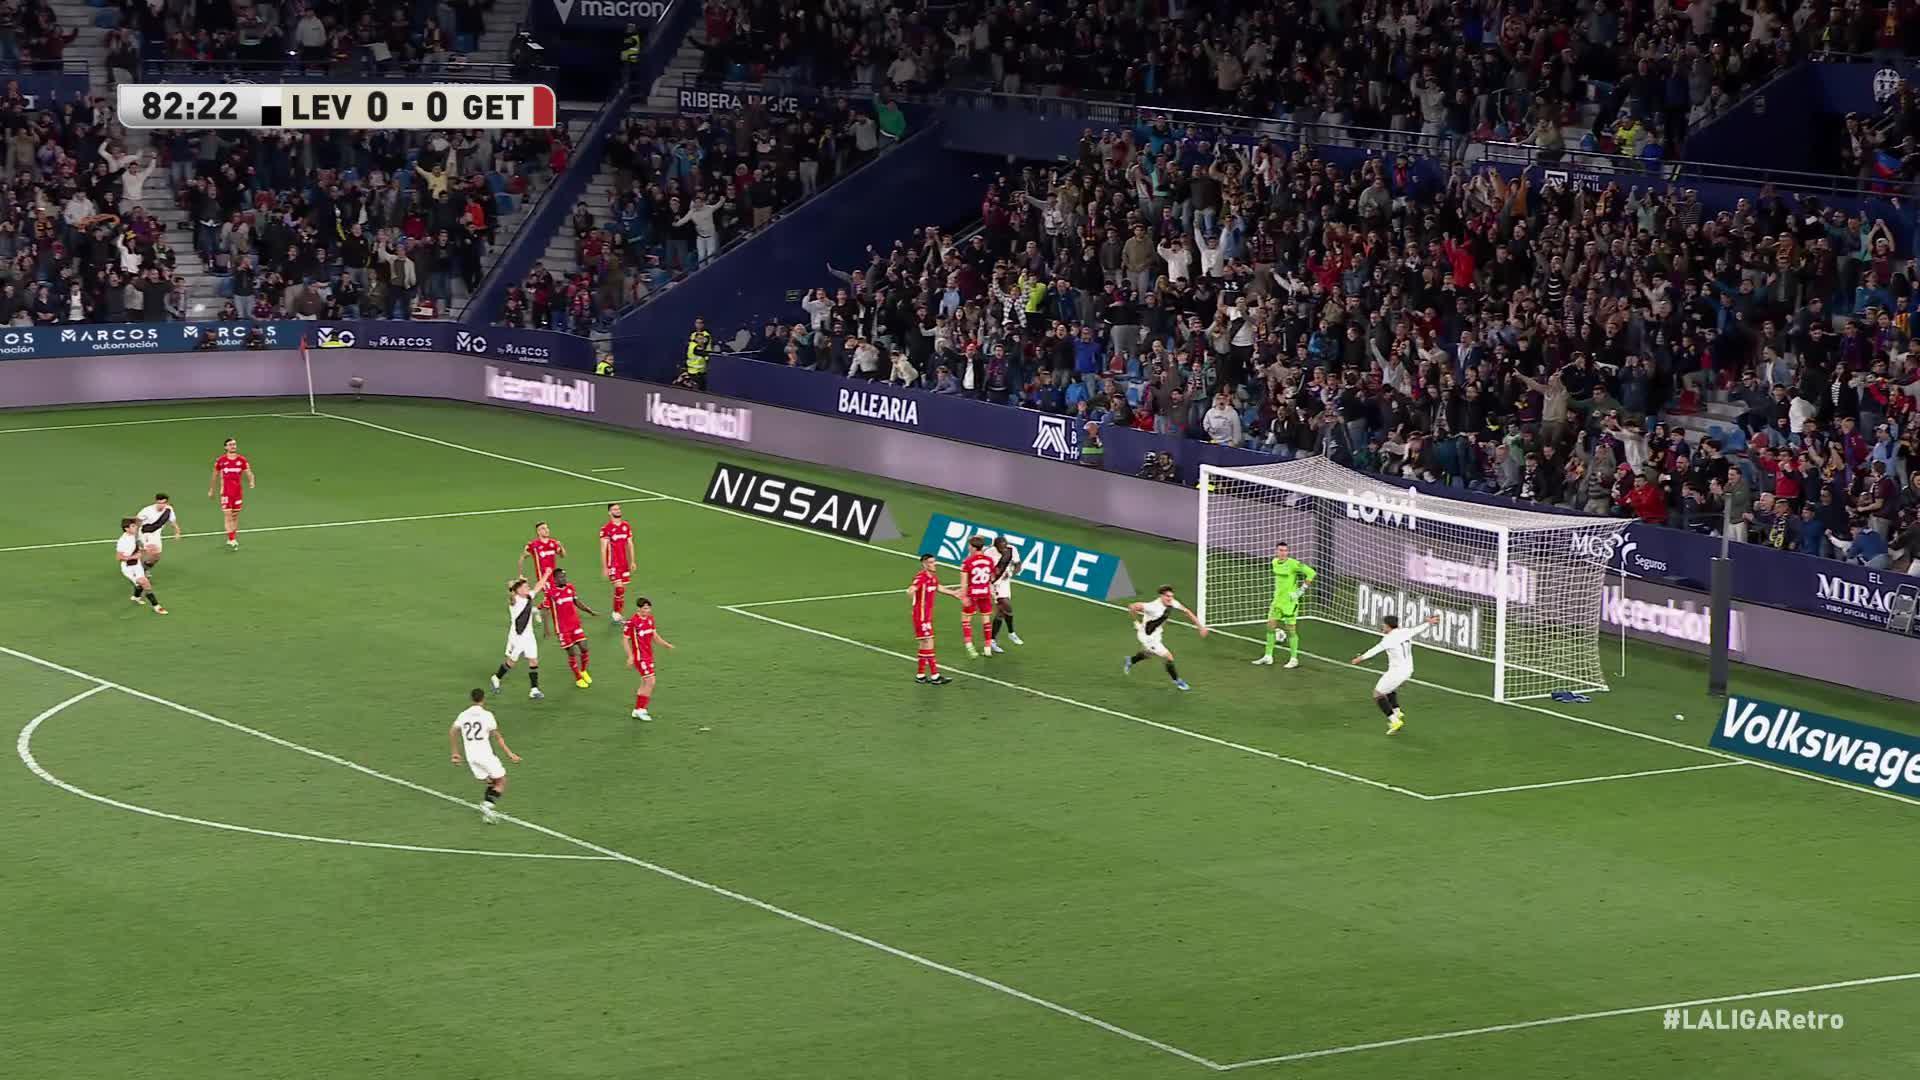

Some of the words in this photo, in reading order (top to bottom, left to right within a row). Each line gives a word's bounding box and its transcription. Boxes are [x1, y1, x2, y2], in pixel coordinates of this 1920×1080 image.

[581, 1, 664, 17] macron
[680, 91, 742, 109] RIBERA
[61, 329, 158, 342] MARCOS
[184, 326, 276, 338] MRCS
[92, 341, 158, 350] automoción
[379, 336, 432, 346] MARCOS
[505, 344, 549, 357] MARCOS
[710, 469, 878, 536] NISSAN
[1571, 533, 1614, 560] MGS
[1635, 554, 1667, 571] Seguros
[971, 567, 991, 584] 26
[1868, 572, 1883, 584] EL
[1816, 573, 1913, 615] MIRAC
[463, 721, 484, 741] 22
[1724, 698, 1920, 788] Volkswage
